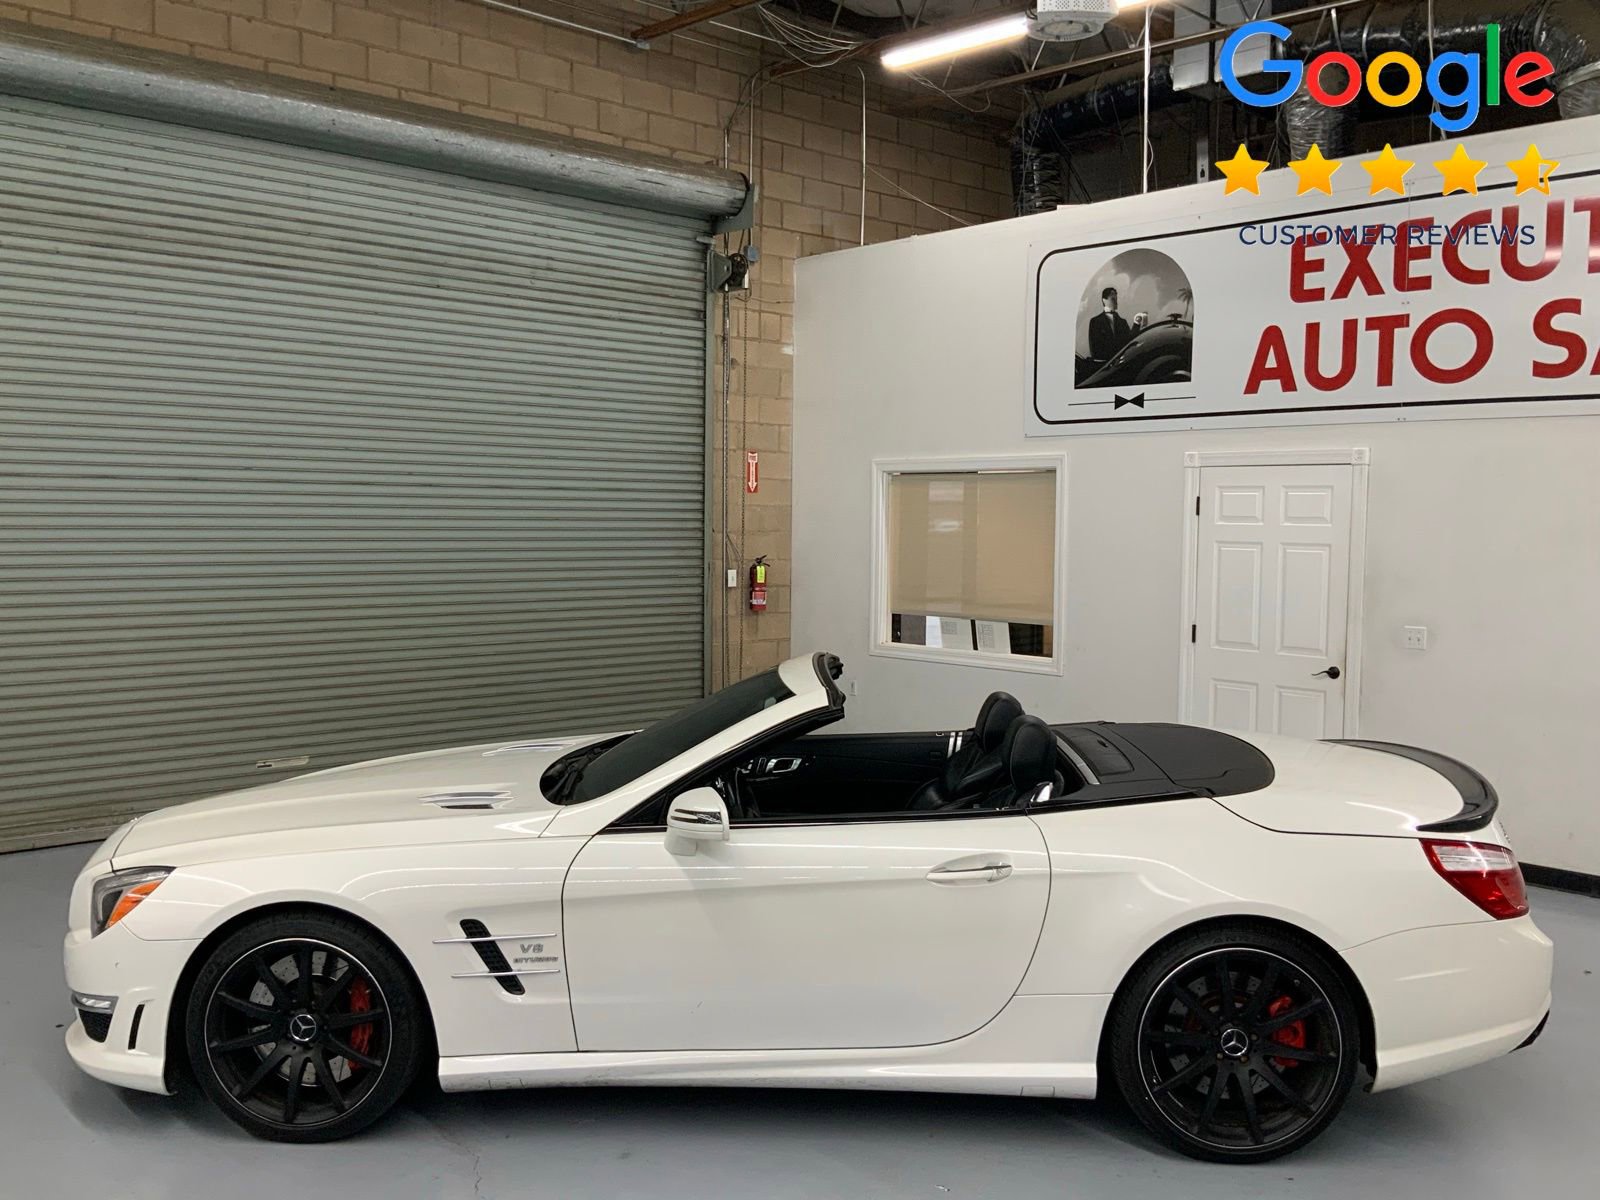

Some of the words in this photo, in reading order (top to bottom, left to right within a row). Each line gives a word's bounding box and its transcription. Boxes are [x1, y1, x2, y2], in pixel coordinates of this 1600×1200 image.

[1244, 307, 1494, 395] AUTO
[1531, 297, 1600, 379] S
[520, 943, 544, 954] V8
